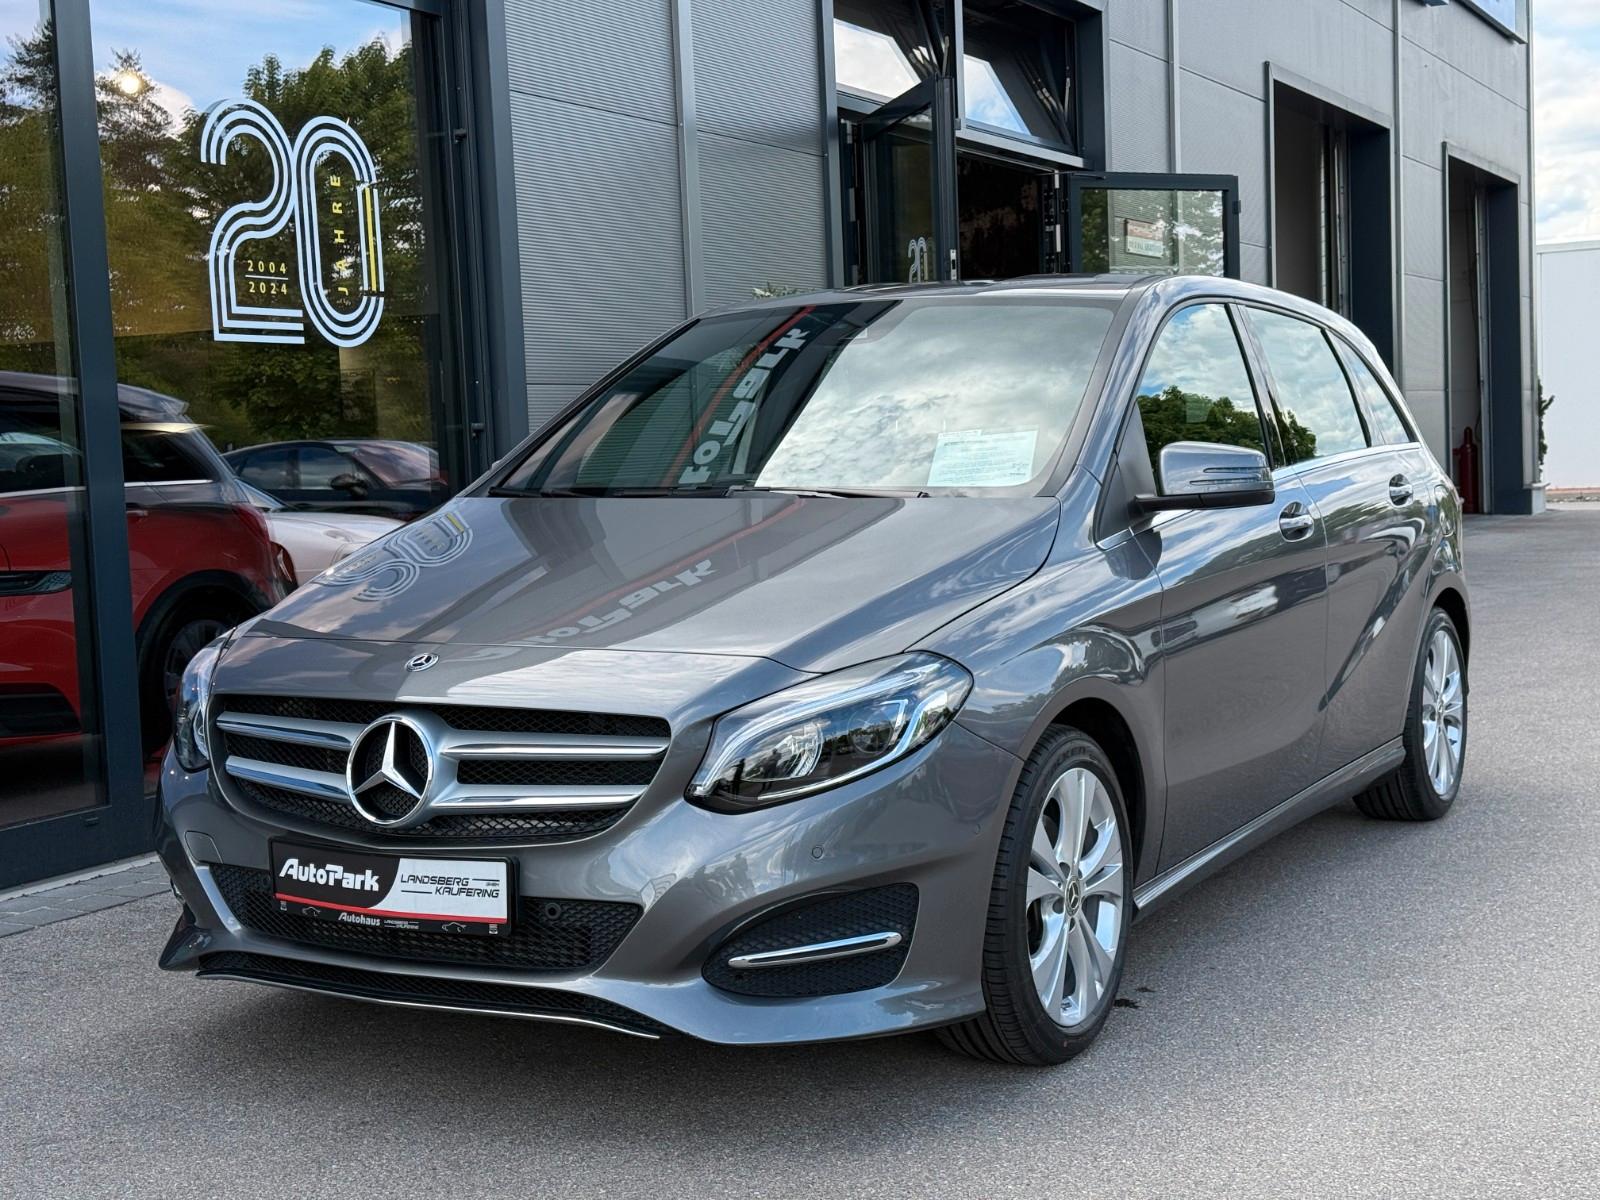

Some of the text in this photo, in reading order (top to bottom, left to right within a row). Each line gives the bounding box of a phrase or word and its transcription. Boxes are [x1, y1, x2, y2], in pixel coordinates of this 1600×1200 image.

[200, 98, 385, 348] 20
[330, 174, 350, 296] JAHRE
[247, 260, 287, 274] 2004
[248, 281, 288, 295] 2024
[279, 858, 380, 892] AutoPark
[400, 874, 470, 886] LANDSBERG
[434, 885, 500, 899] KAUFERING
[338, 911, 381, 927] Autohaus
